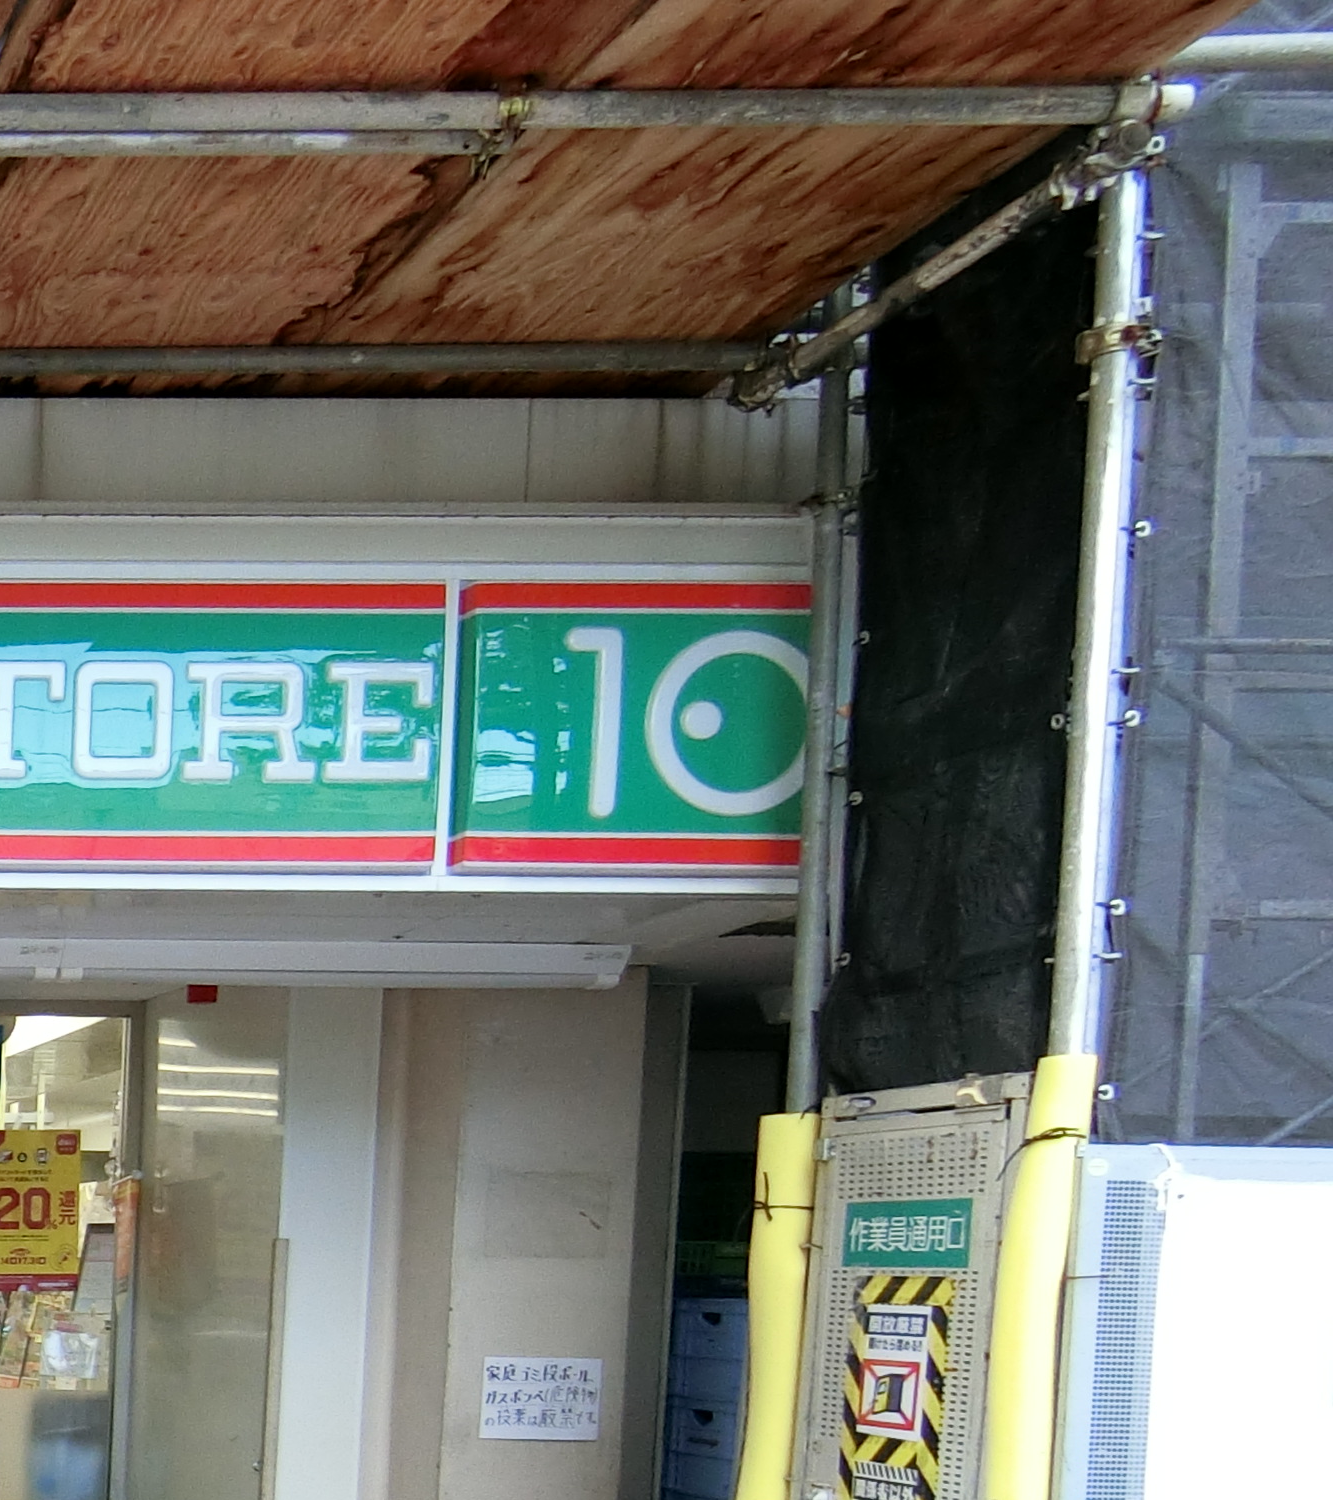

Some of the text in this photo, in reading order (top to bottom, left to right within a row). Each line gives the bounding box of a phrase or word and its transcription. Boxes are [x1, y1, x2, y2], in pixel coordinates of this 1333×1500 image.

[848, 1215, 966, 1252] 作業員通用口
